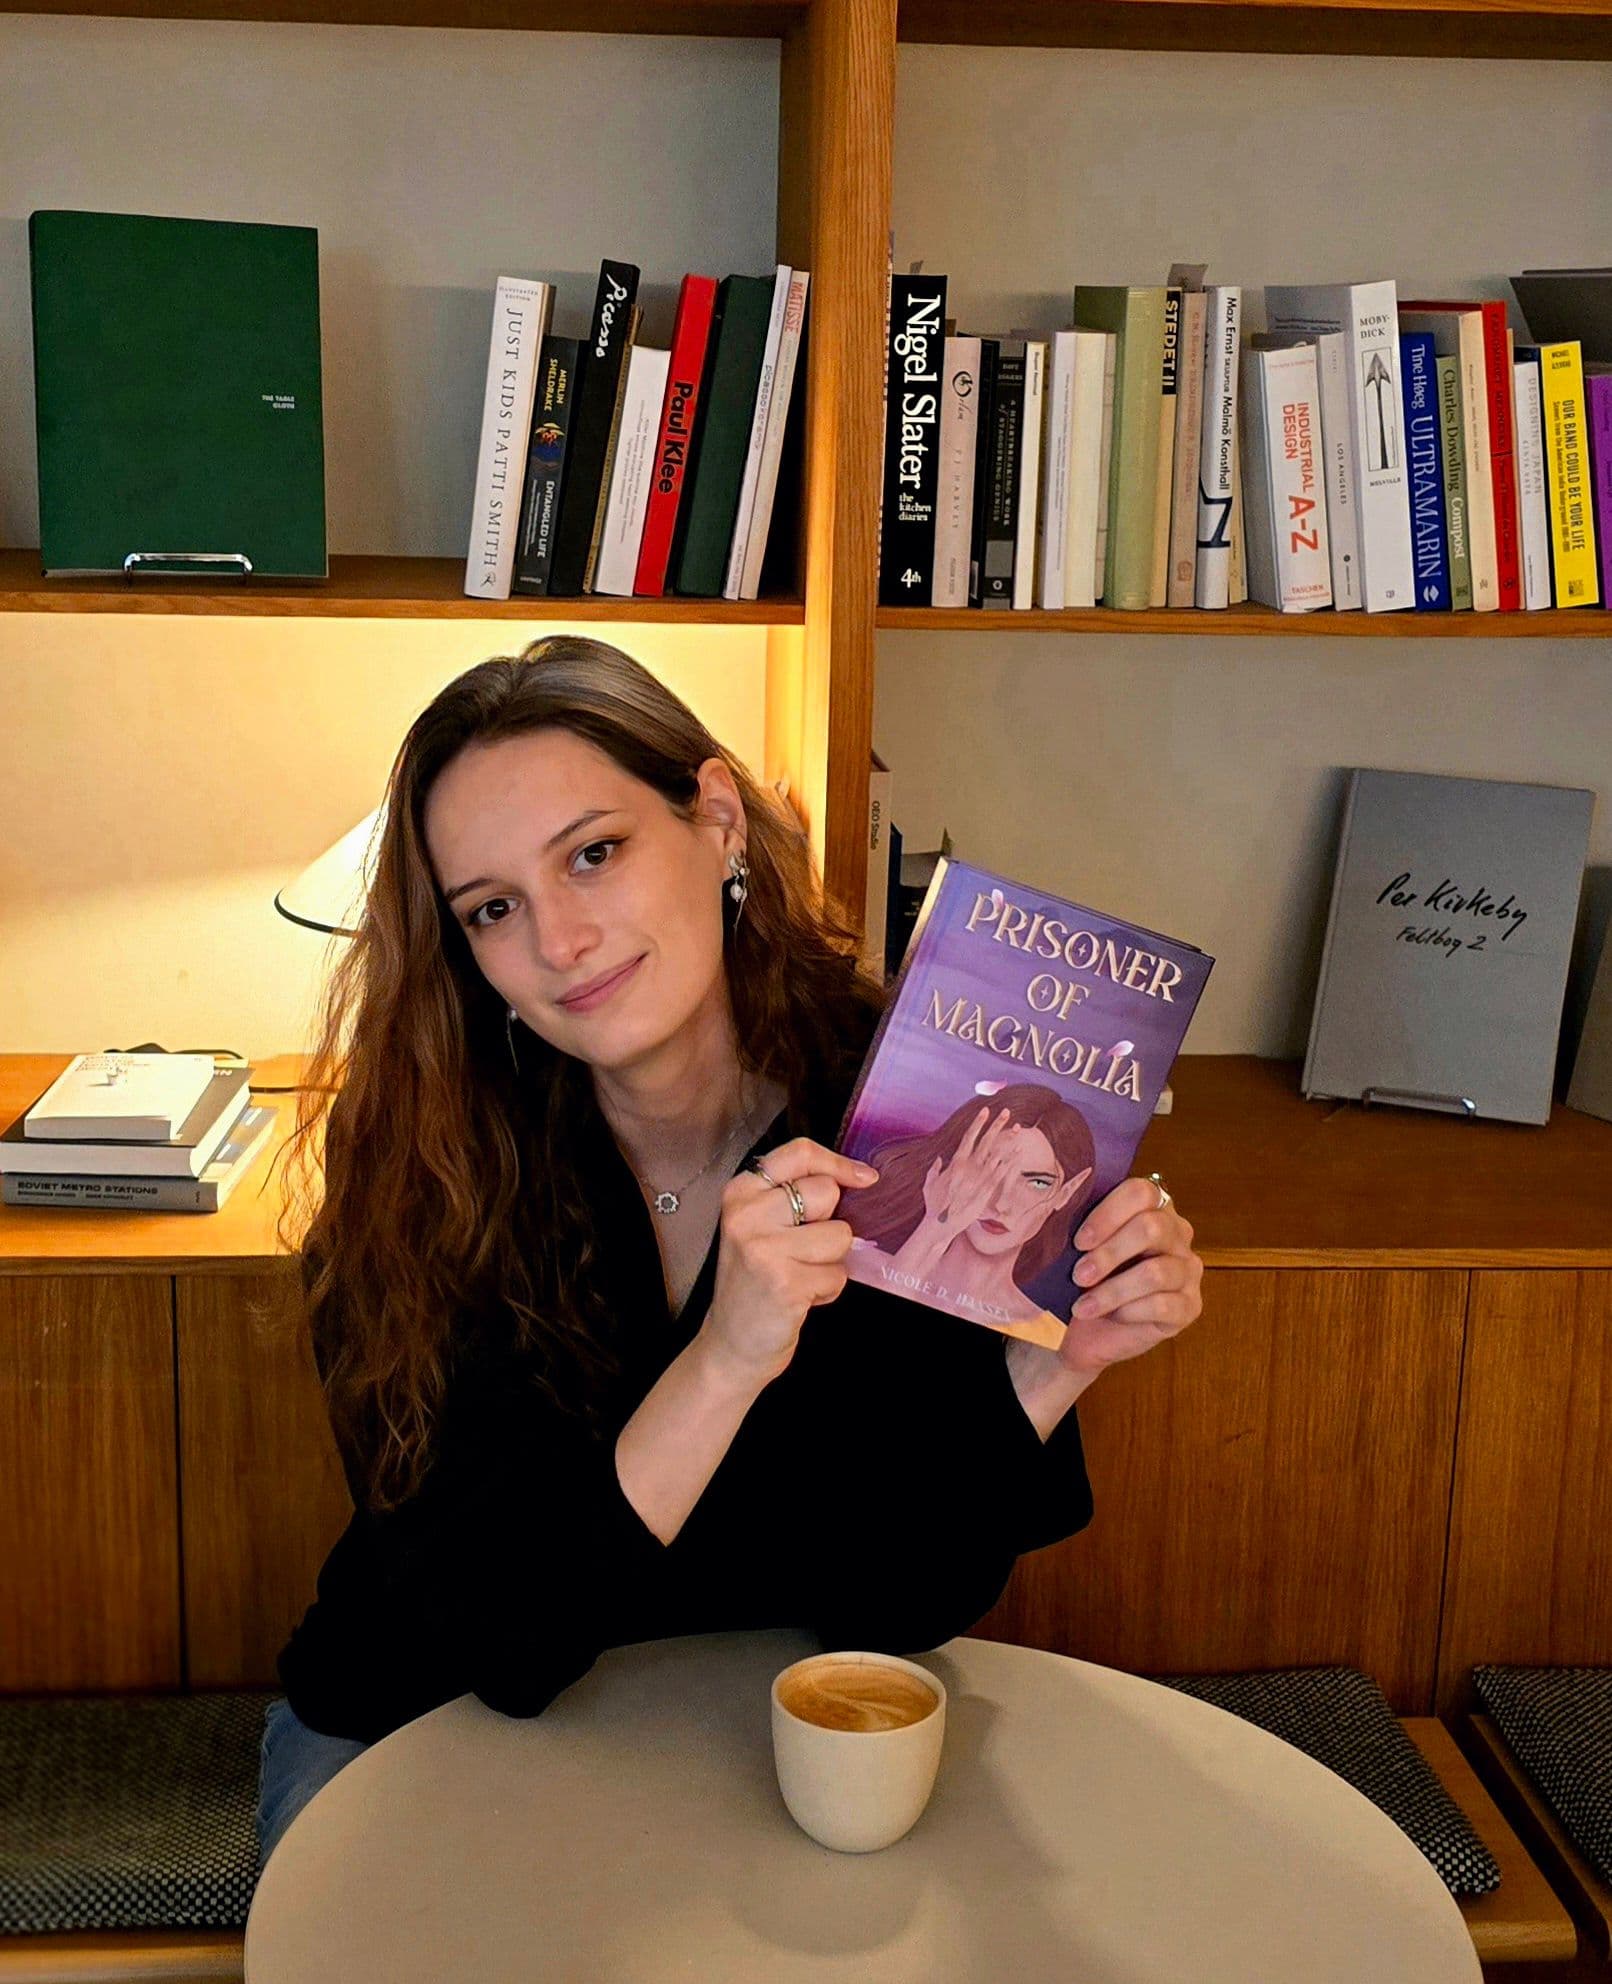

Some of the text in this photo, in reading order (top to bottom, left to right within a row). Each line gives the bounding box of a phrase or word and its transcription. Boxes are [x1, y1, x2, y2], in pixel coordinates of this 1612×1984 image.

[595, 273, 627, 357] Picasso
[785, 281, 804, 335] MATISSE
[1226, 297, 1237, 323] Max
[1360, 327, 1386, 339] DICK
[1163, 300, 1179, 371] STEDET
[1225, 327, 1236, 355] Ernst
[1411, 344, 1426, 374] Tine
[544, 358, 558, 411] SHELDRAKE
[556, 369, 567, 404] MERLIN
[894, 293, 941, 490] Nigel Slater
[484, 308, 523, 566] JUST KIDS PATTI SMITH
[659, 381, 694, 494] Paul Klee
[1222, 395, 1233, 435] Malmö
[1282, 404, 1299, 460] DESIGN
[1219, 438, 1231, 490] Konsthall
[1297, 402, 1314, 493] INDUSTRIAL
[1442, 369, 1465, 559] Charles Dowding Compost
[1532, 453, 1542, 494] JAPAN
[898, 493, 914, 503] the
[1338, 464, 1347, 505] ANGELES
[1411, 415, 1442, 578] ULTRAMARIN
[1562, 400, 1585, 550] OUR BAND COULD BE YOUR LIFE
[537, 480, 555, 558] ENTANGLED LIFE
[898, 512, 928, 521] diaries
[899, 502, 931, 513] kitchen
[1288, 495, 1319, 554] A-Z
[1376, 872, 1417, 907] Per
[965, 892, 1183, 1003] PRISONER
[1467, 936, 1488, 951] 2
[1027, 973, 1091, 1020] OF
[921, 989, 1142, 1102] MAGNOLIA
[17, 1181, 59, 1191] SOVIET
[61, 1183, 101, 1192] METRO
[104, 1185, 158, 1195] STATIONS
[880, 1265, 932, 1294] NICOLE
